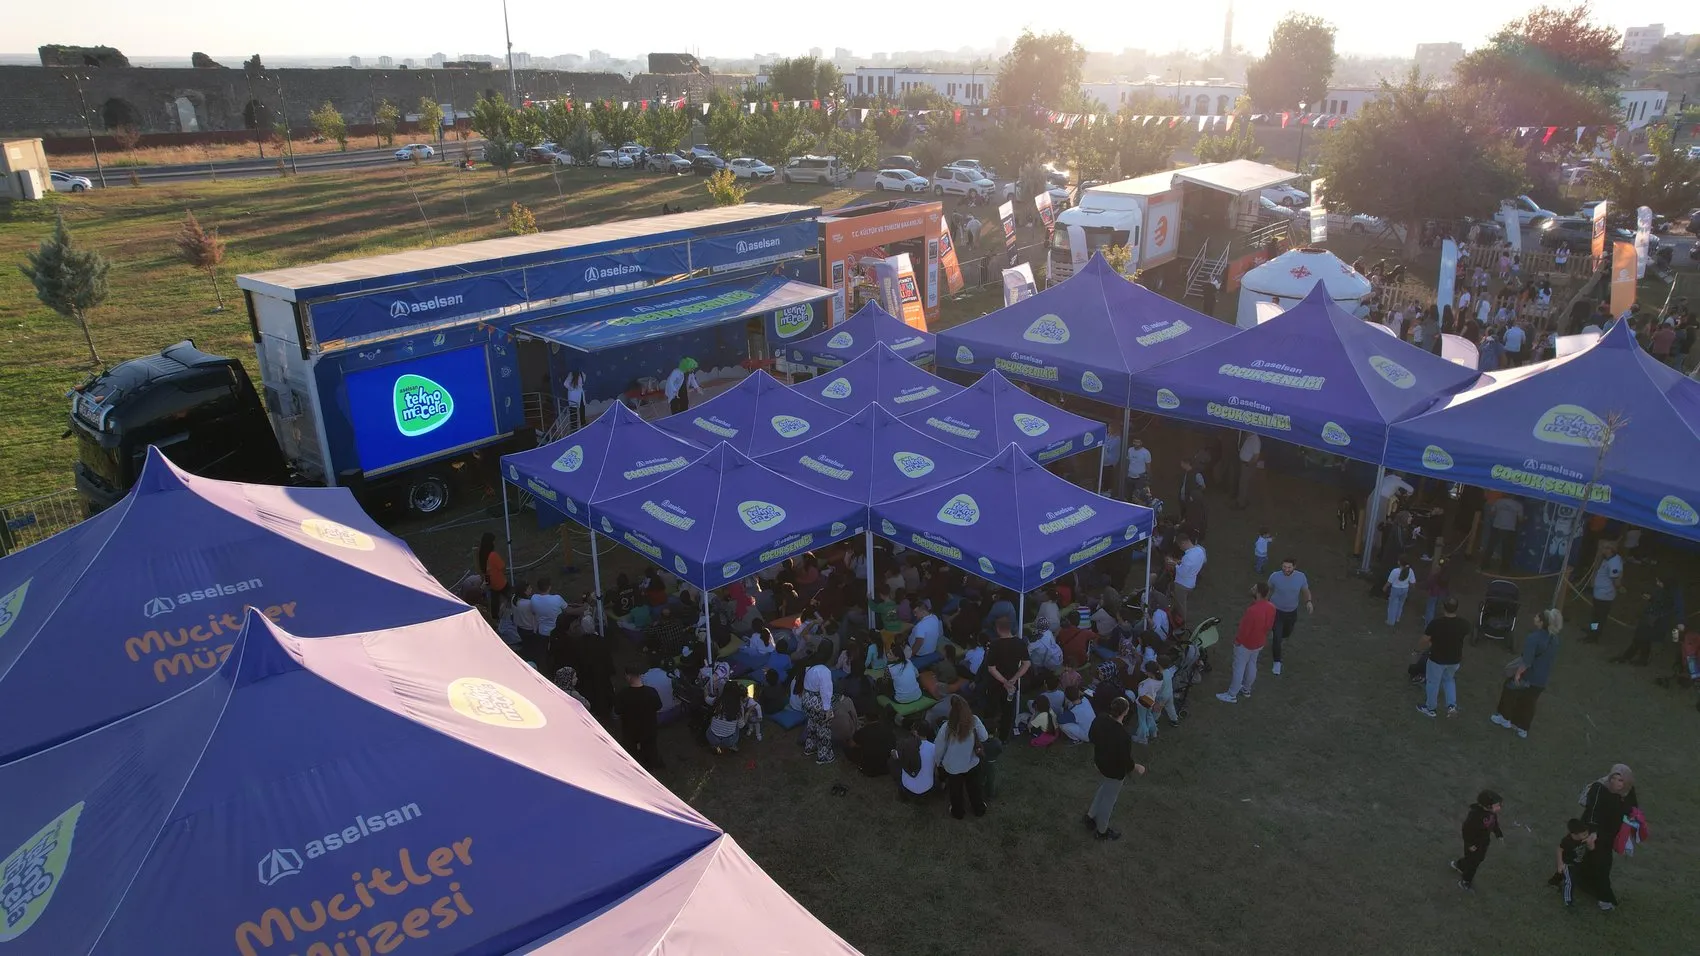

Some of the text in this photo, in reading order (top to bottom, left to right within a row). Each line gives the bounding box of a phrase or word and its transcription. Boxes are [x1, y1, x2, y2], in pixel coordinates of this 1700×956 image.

[748, 236, 780, 252] aselsan
[600, 264, 642, 280] aselsan
[411, 292, 464, 314] aselsan
[1264, 362, 1302, 374] aselsan
[404, 386, 442, 408] tekno
[1240, 399, 1271, 412] aselsan
[402, 400, 448, 421] macera
[1540, 462, 1583, 480] aselsan
[178, 576, 264, 606] aselsan
[124, 602, 297, 662] Muciter
[153, 644, 234, 683] Müz
[304, 802, 422, 860] aselsan
[235, 836, 472, 956] Mucitler
